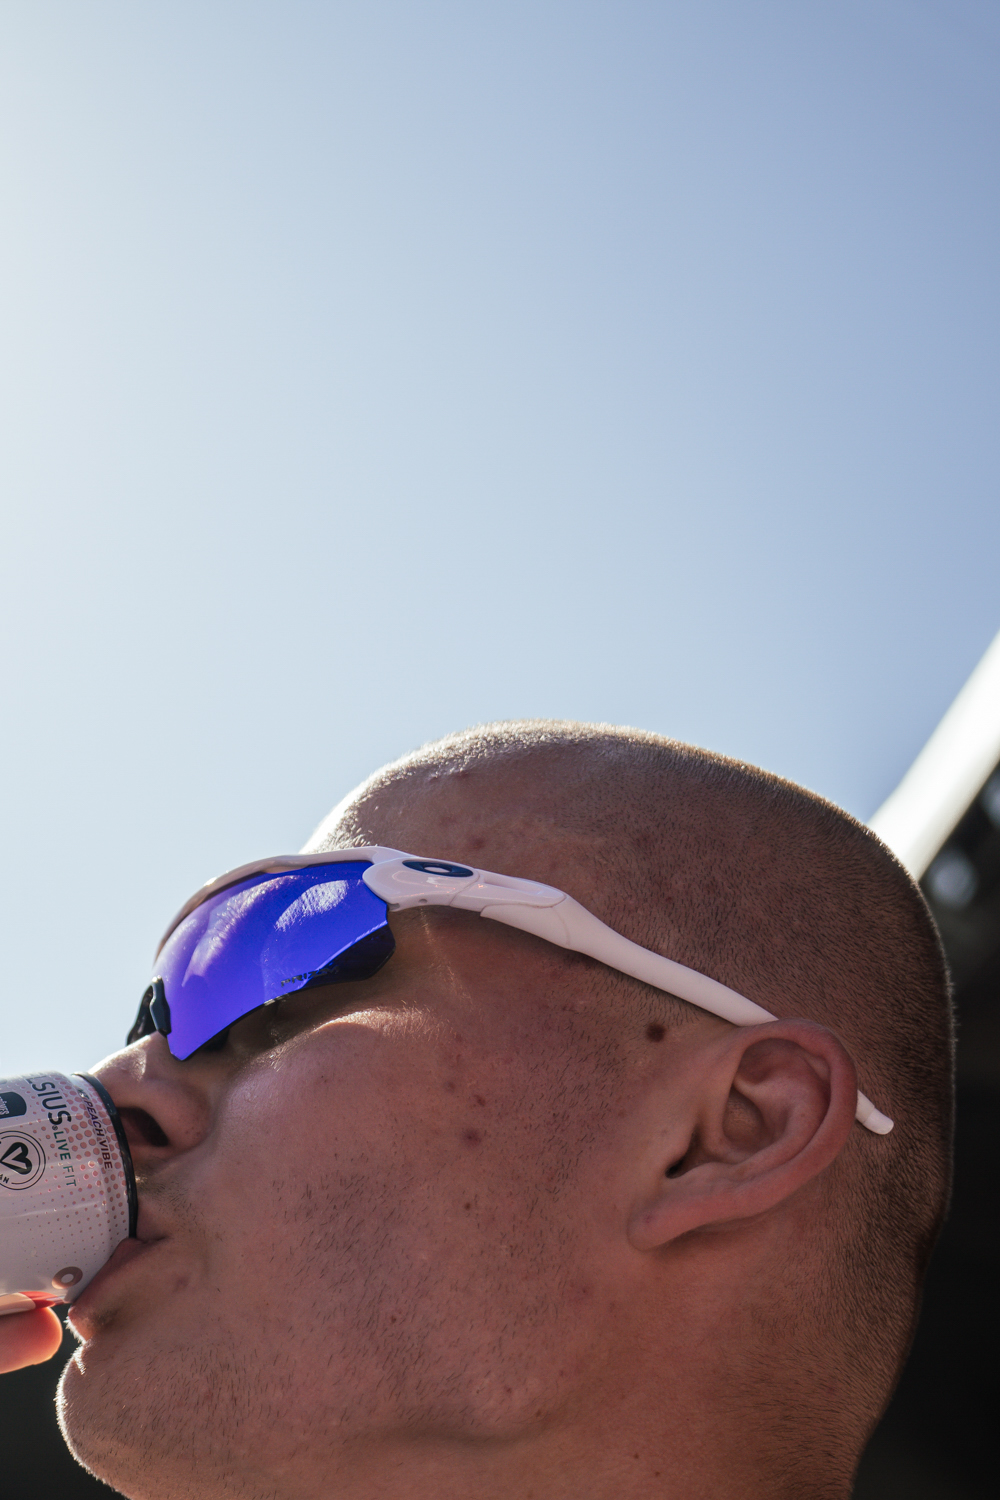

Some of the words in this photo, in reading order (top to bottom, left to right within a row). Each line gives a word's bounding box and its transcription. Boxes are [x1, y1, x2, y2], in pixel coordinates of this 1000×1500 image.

[52, 1130, 71, 1161] LIVE
[83, 1098, 105, 1137] PEACH
[98, 1137, 113, 1169] VIBE
[61, 1164, 78, 1188] FIT
